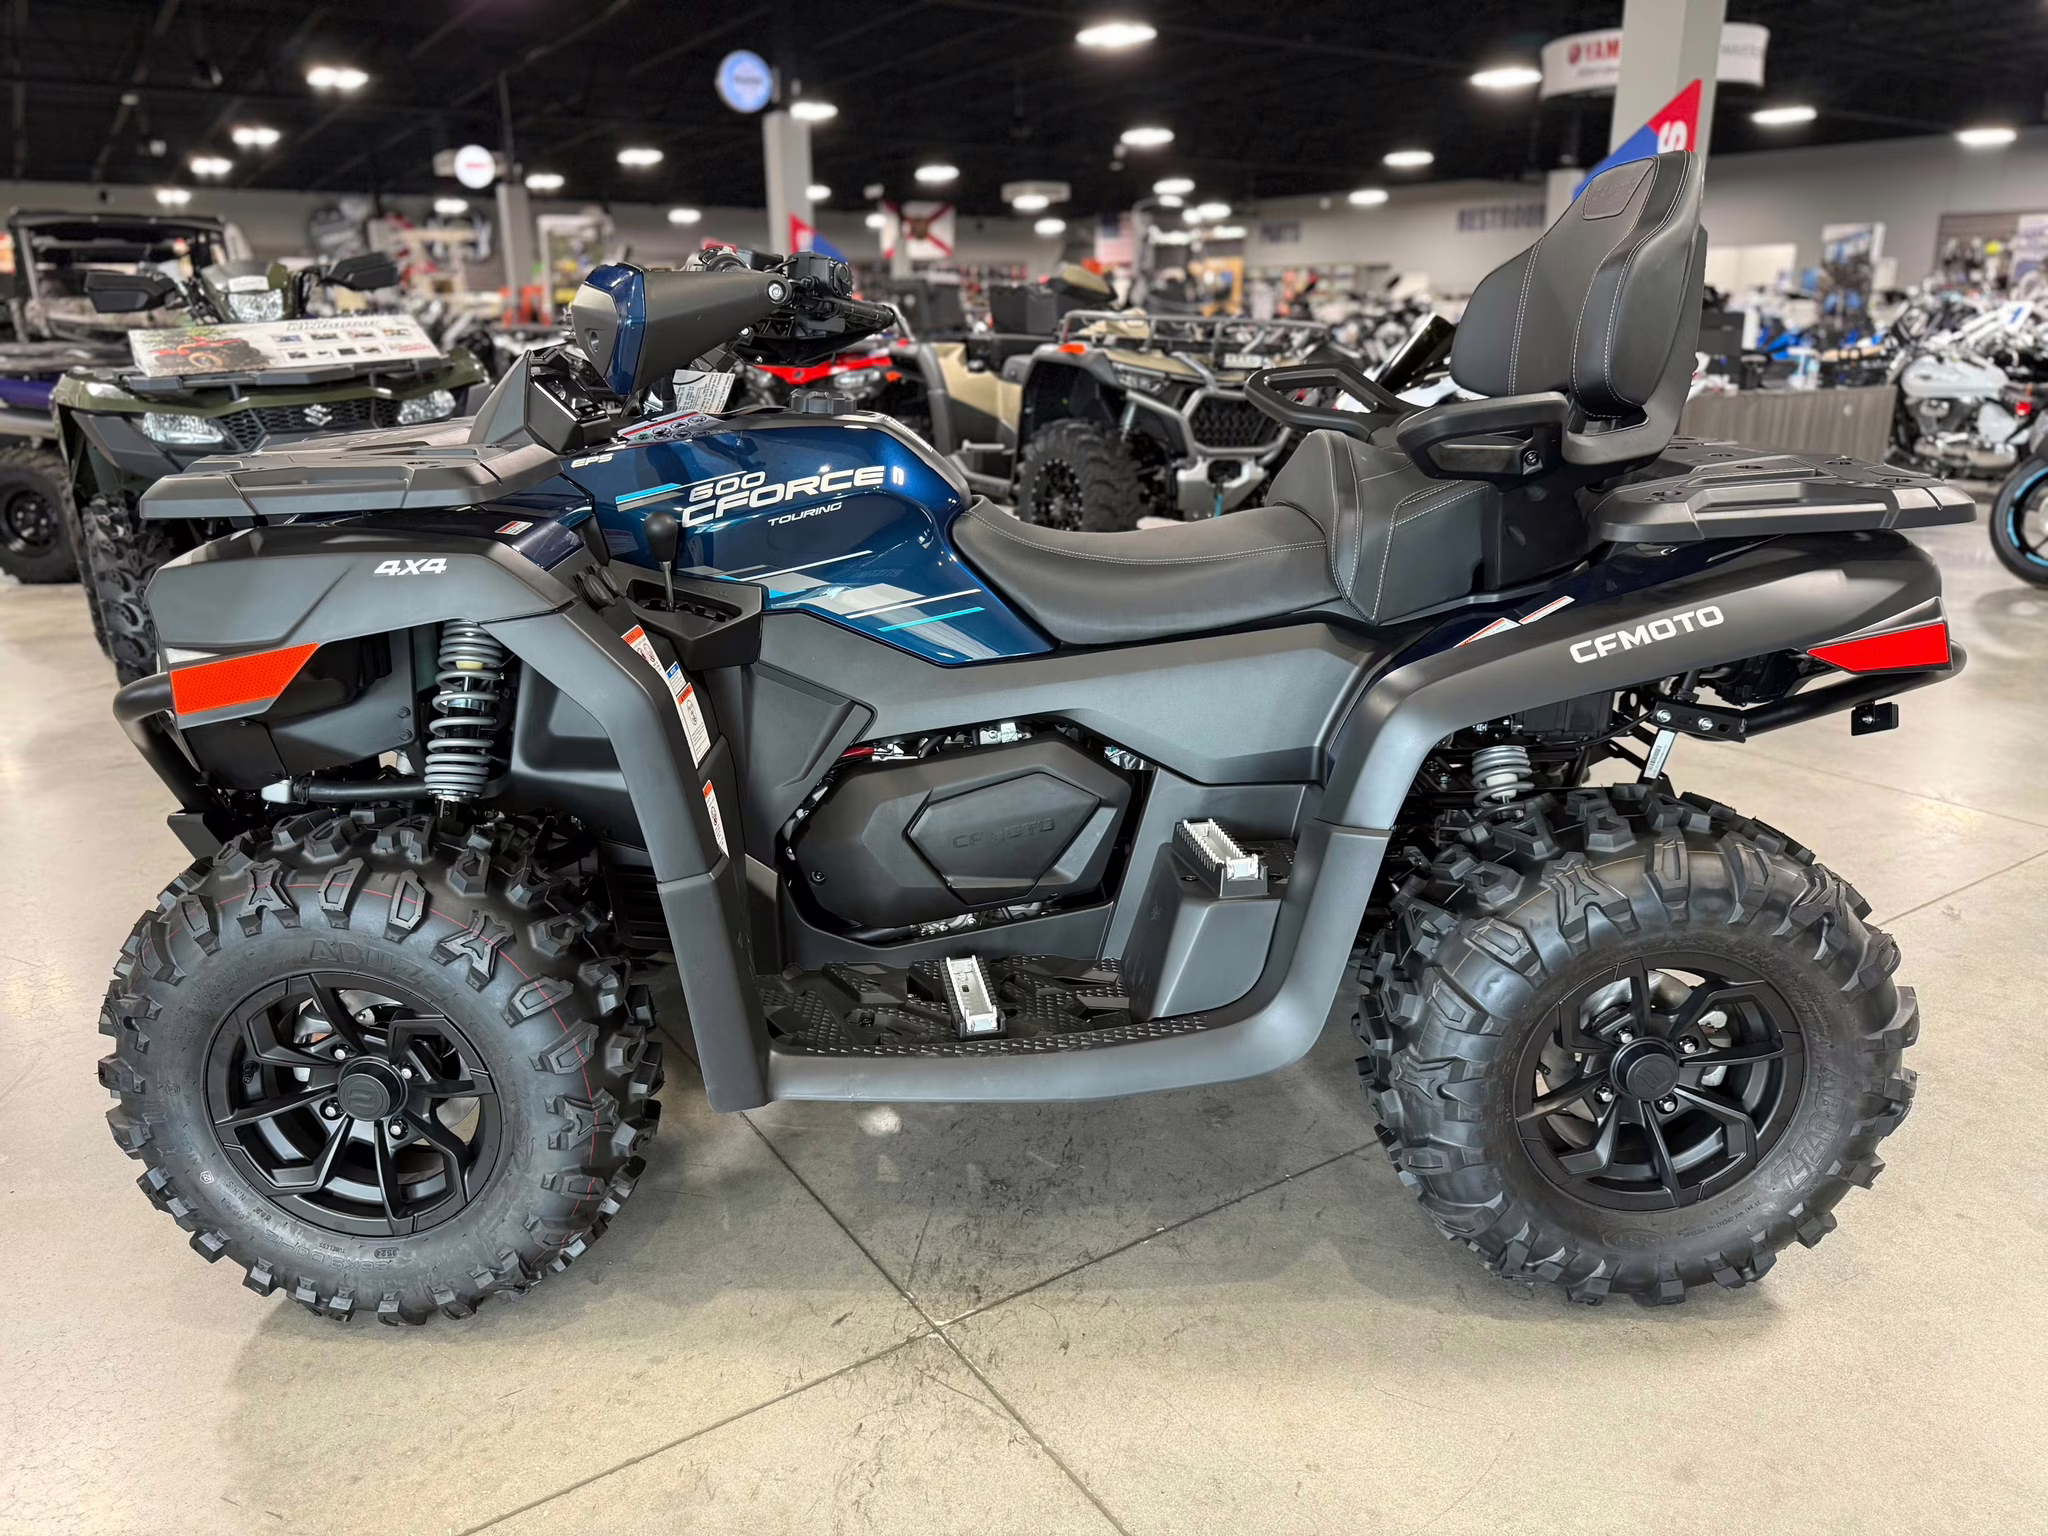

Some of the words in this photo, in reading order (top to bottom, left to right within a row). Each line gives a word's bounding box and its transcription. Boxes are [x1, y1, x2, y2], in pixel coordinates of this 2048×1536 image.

[1586, 39, 1620, 61] YAM
[571, 453, 614, 468] EPS
[682, 465, 886, 528] CFORCE
[689, 471, 766, 503] 600
[767, 501, 842, 527] TOURING
[374, 558, 447, 576] 4X4
[1570, 605, 1725, 664] CFMOTO
[952, 817, 1055, 848] CFMOTO
